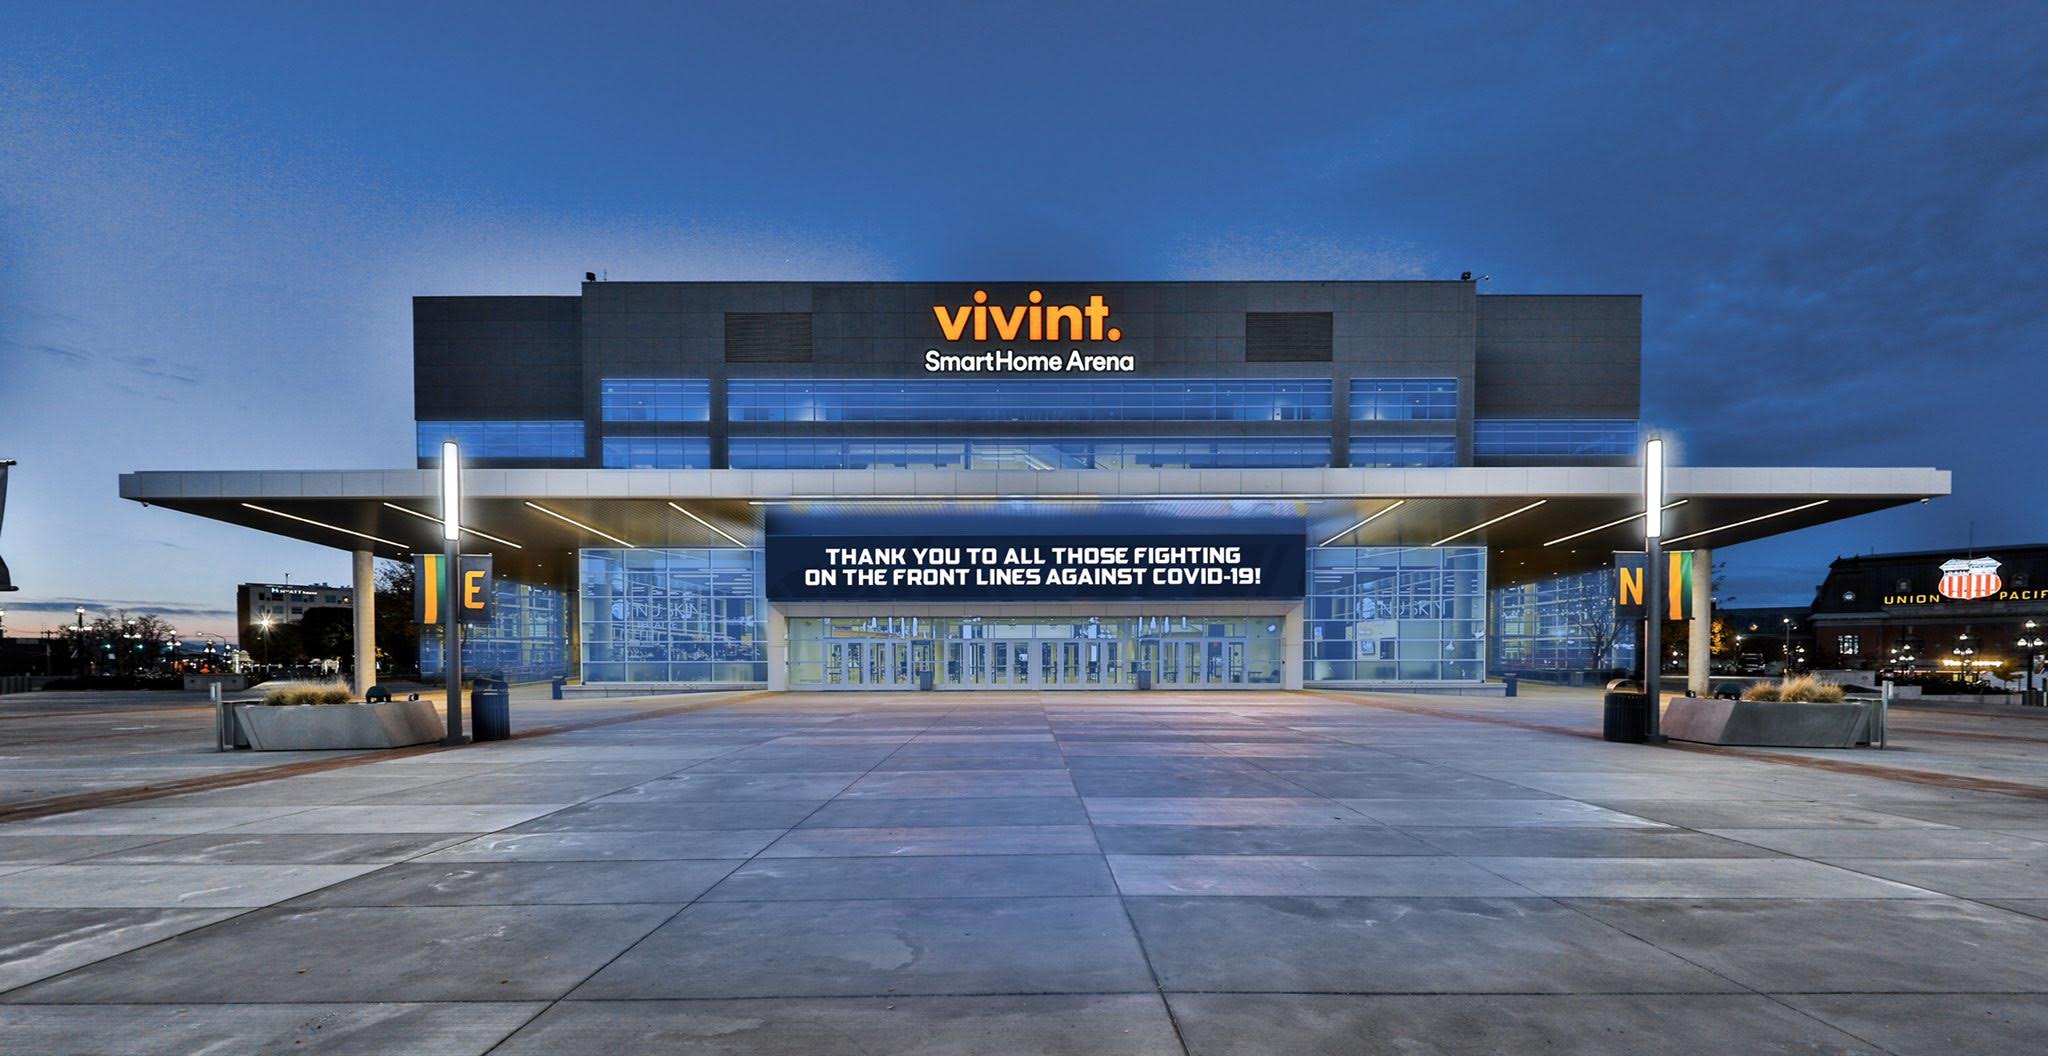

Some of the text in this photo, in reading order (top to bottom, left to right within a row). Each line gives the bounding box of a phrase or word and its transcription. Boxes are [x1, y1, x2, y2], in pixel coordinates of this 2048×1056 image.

[933, 290, 1121, 342] vivint.
[1066, 350, 1134, 372] Arena
[826, 547, 1240, 565] THANK YOU TO ALL THOSE FIGHTING
[806, 567, 1261, 586] ON THE FRONT LINES AGAINST COVID-19!
[1620, 567, 1643, 605] N
[464, 570, 486, 609] E
[1884, 594, 1940, 605] UNION
